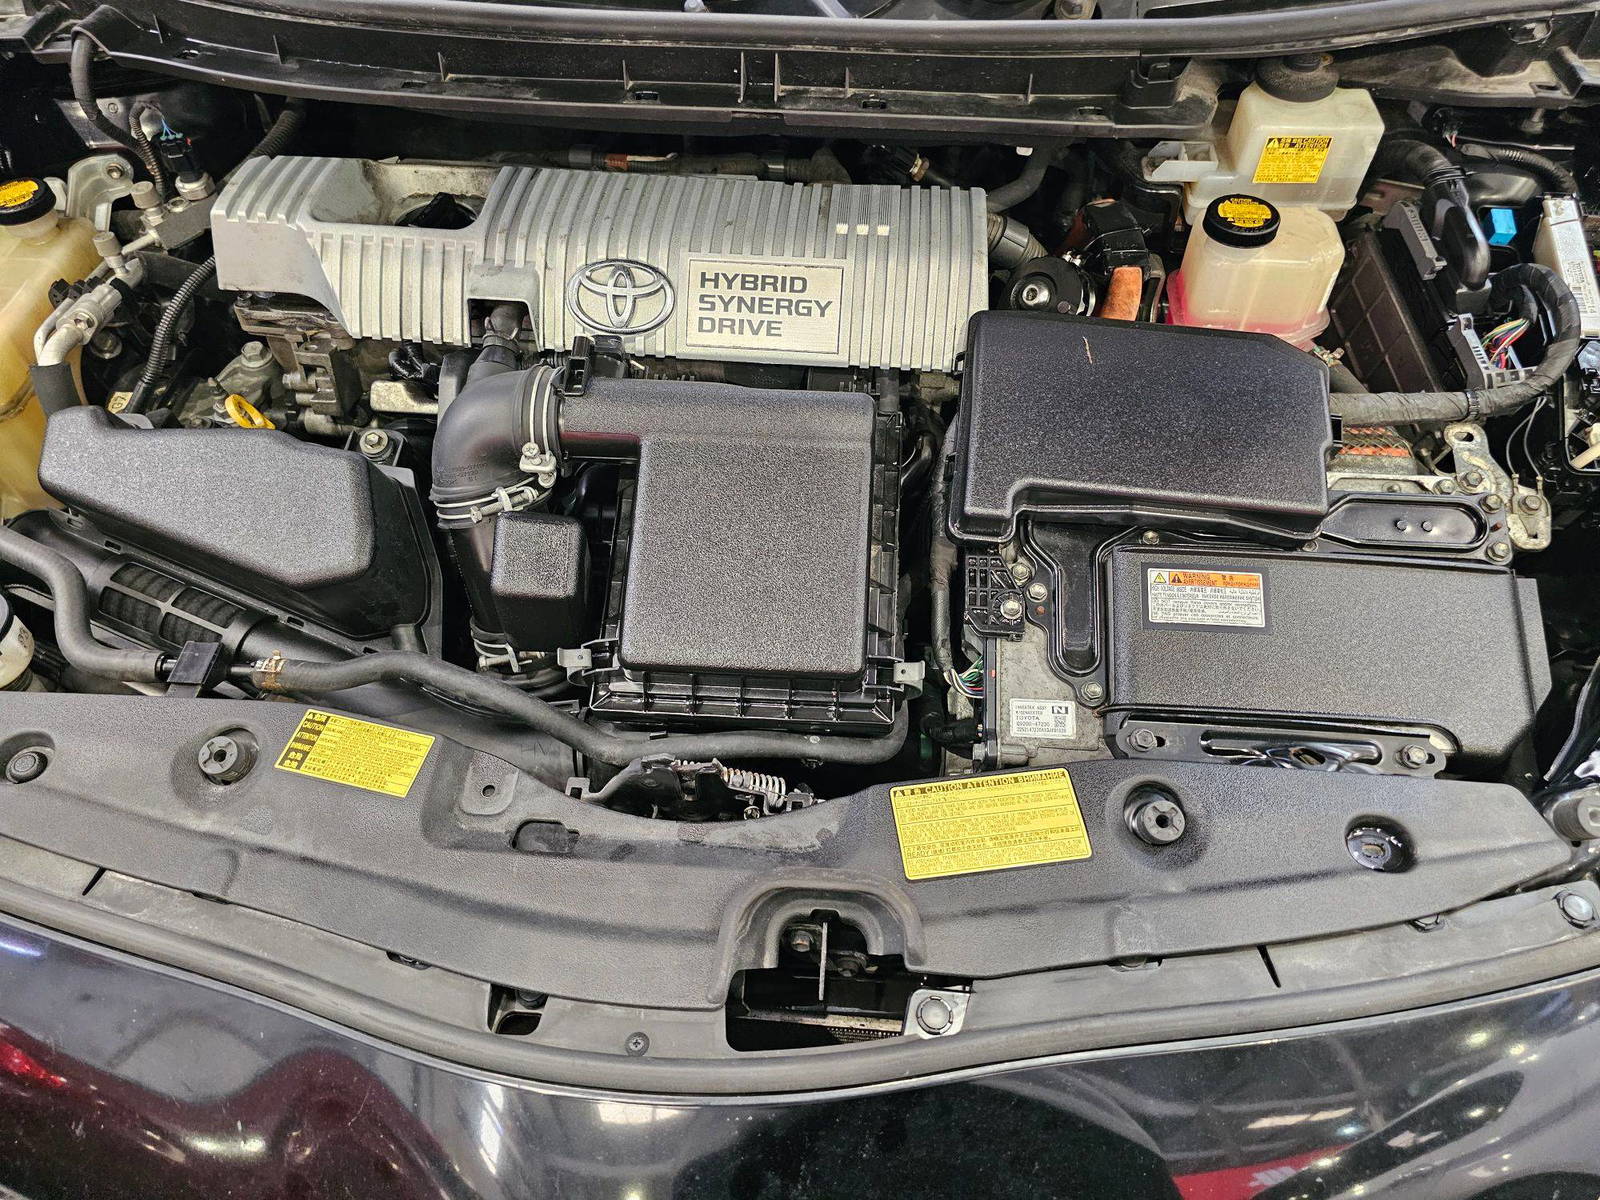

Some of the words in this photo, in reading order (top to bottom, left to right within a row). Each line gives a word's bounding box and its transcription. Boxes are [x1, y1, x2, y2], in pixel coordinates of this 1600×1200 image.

[700, 271, 808, 293] HYBRID
[698, 294, 833, 318] SYNERGY
[697, 316, 783, 337] DRIVE
[1183, 571, 1210, 580] WARNING
[925, 783, 961, 793] CAUTION
[967, 776, 1014, 788] ATTENTION
[1018, 771, 1065, 783] ВНИМАНИЕ
